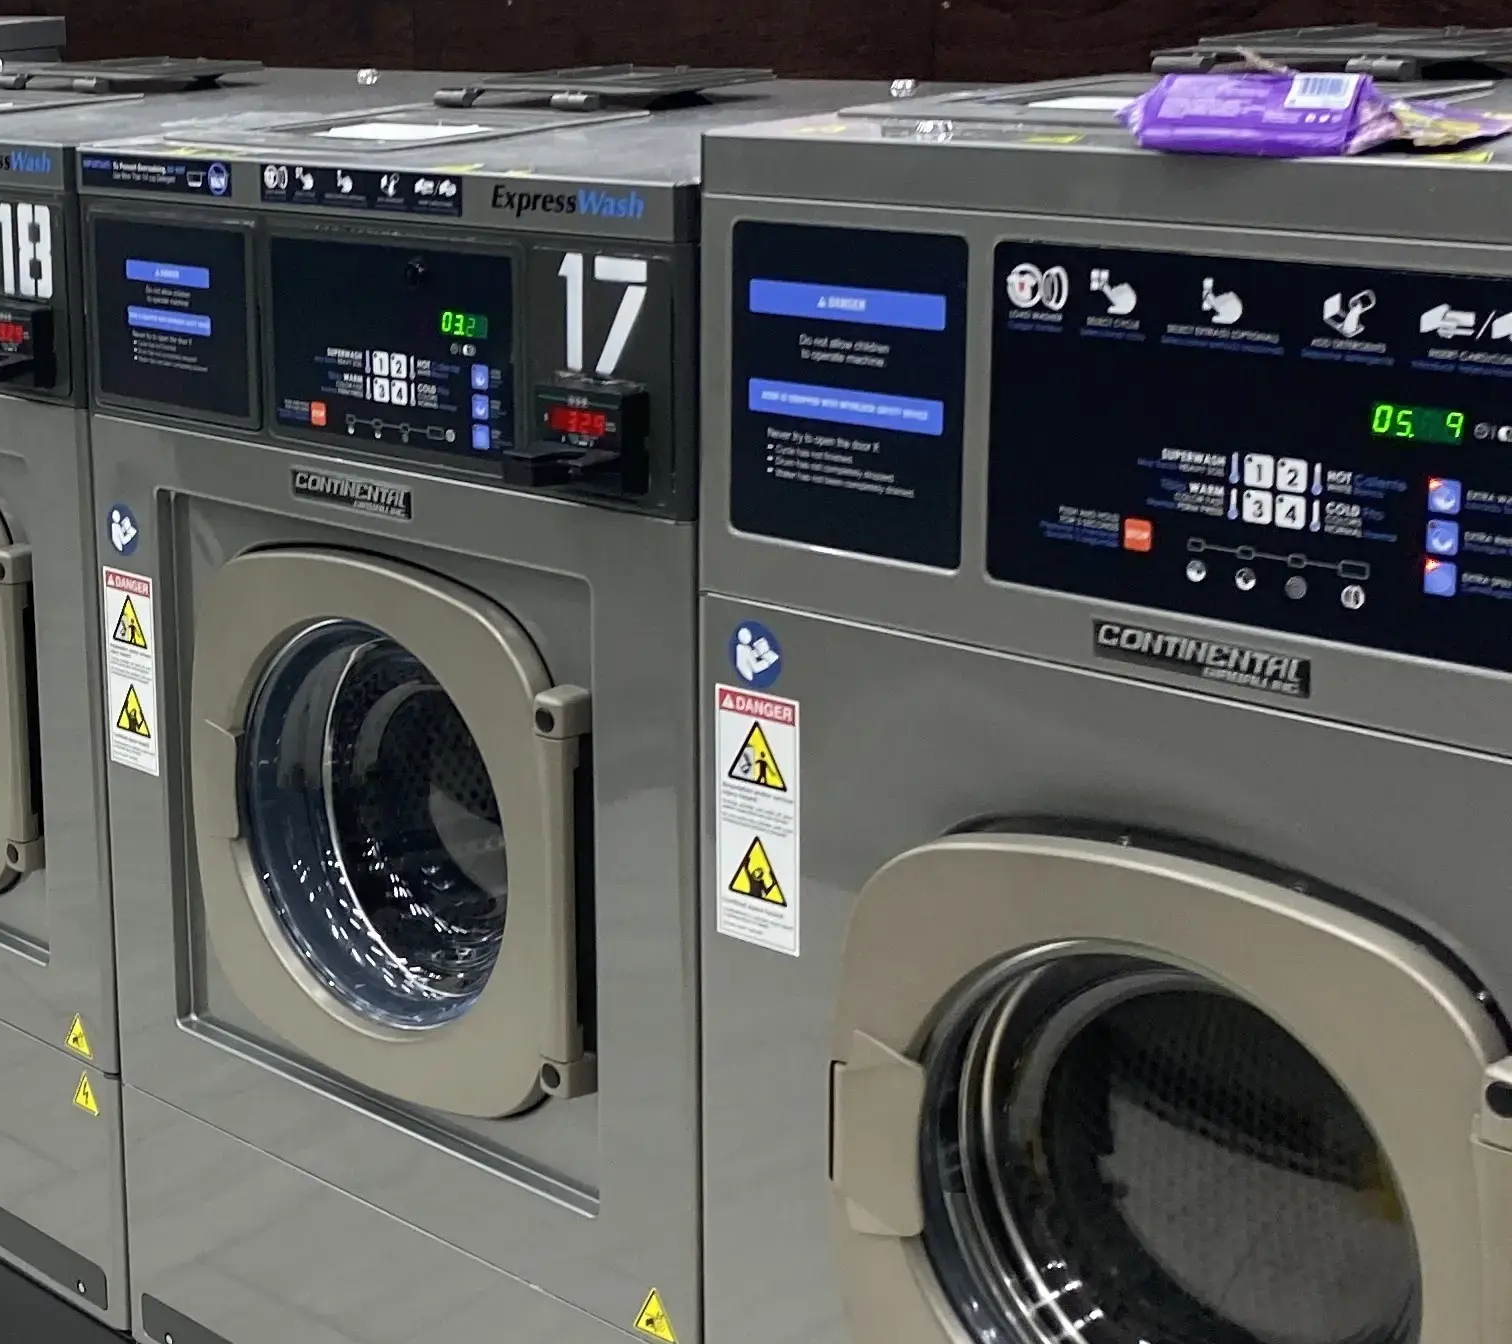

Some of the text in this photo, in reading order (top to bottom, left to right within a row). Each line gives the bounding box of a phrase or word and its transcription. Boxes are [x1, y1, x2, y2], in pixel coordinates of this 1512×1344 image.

[491, 184, 645, 220] ExpressWash
[557, 252, 648, 377] 17
[1445, 411, 1465, 438] 9
[1161, 448, 1227, 468] SUPERWASH
[1255, 464, 1263, 482] 1
[1287, 468, 1299, 486] 2
[1326, 469, 1353, 485] HOT
[294, 472, 408, 508] CONTINENTAL
[1188, 482, 1226, 497] WARM
[1252, 500, 1361, 524] 3 4 COLD
[115, 576, 149, 595] DANGER
[1097, 624, 1301, 683] CONTINENTAL
[735, 695, 793, 723] DANGER
